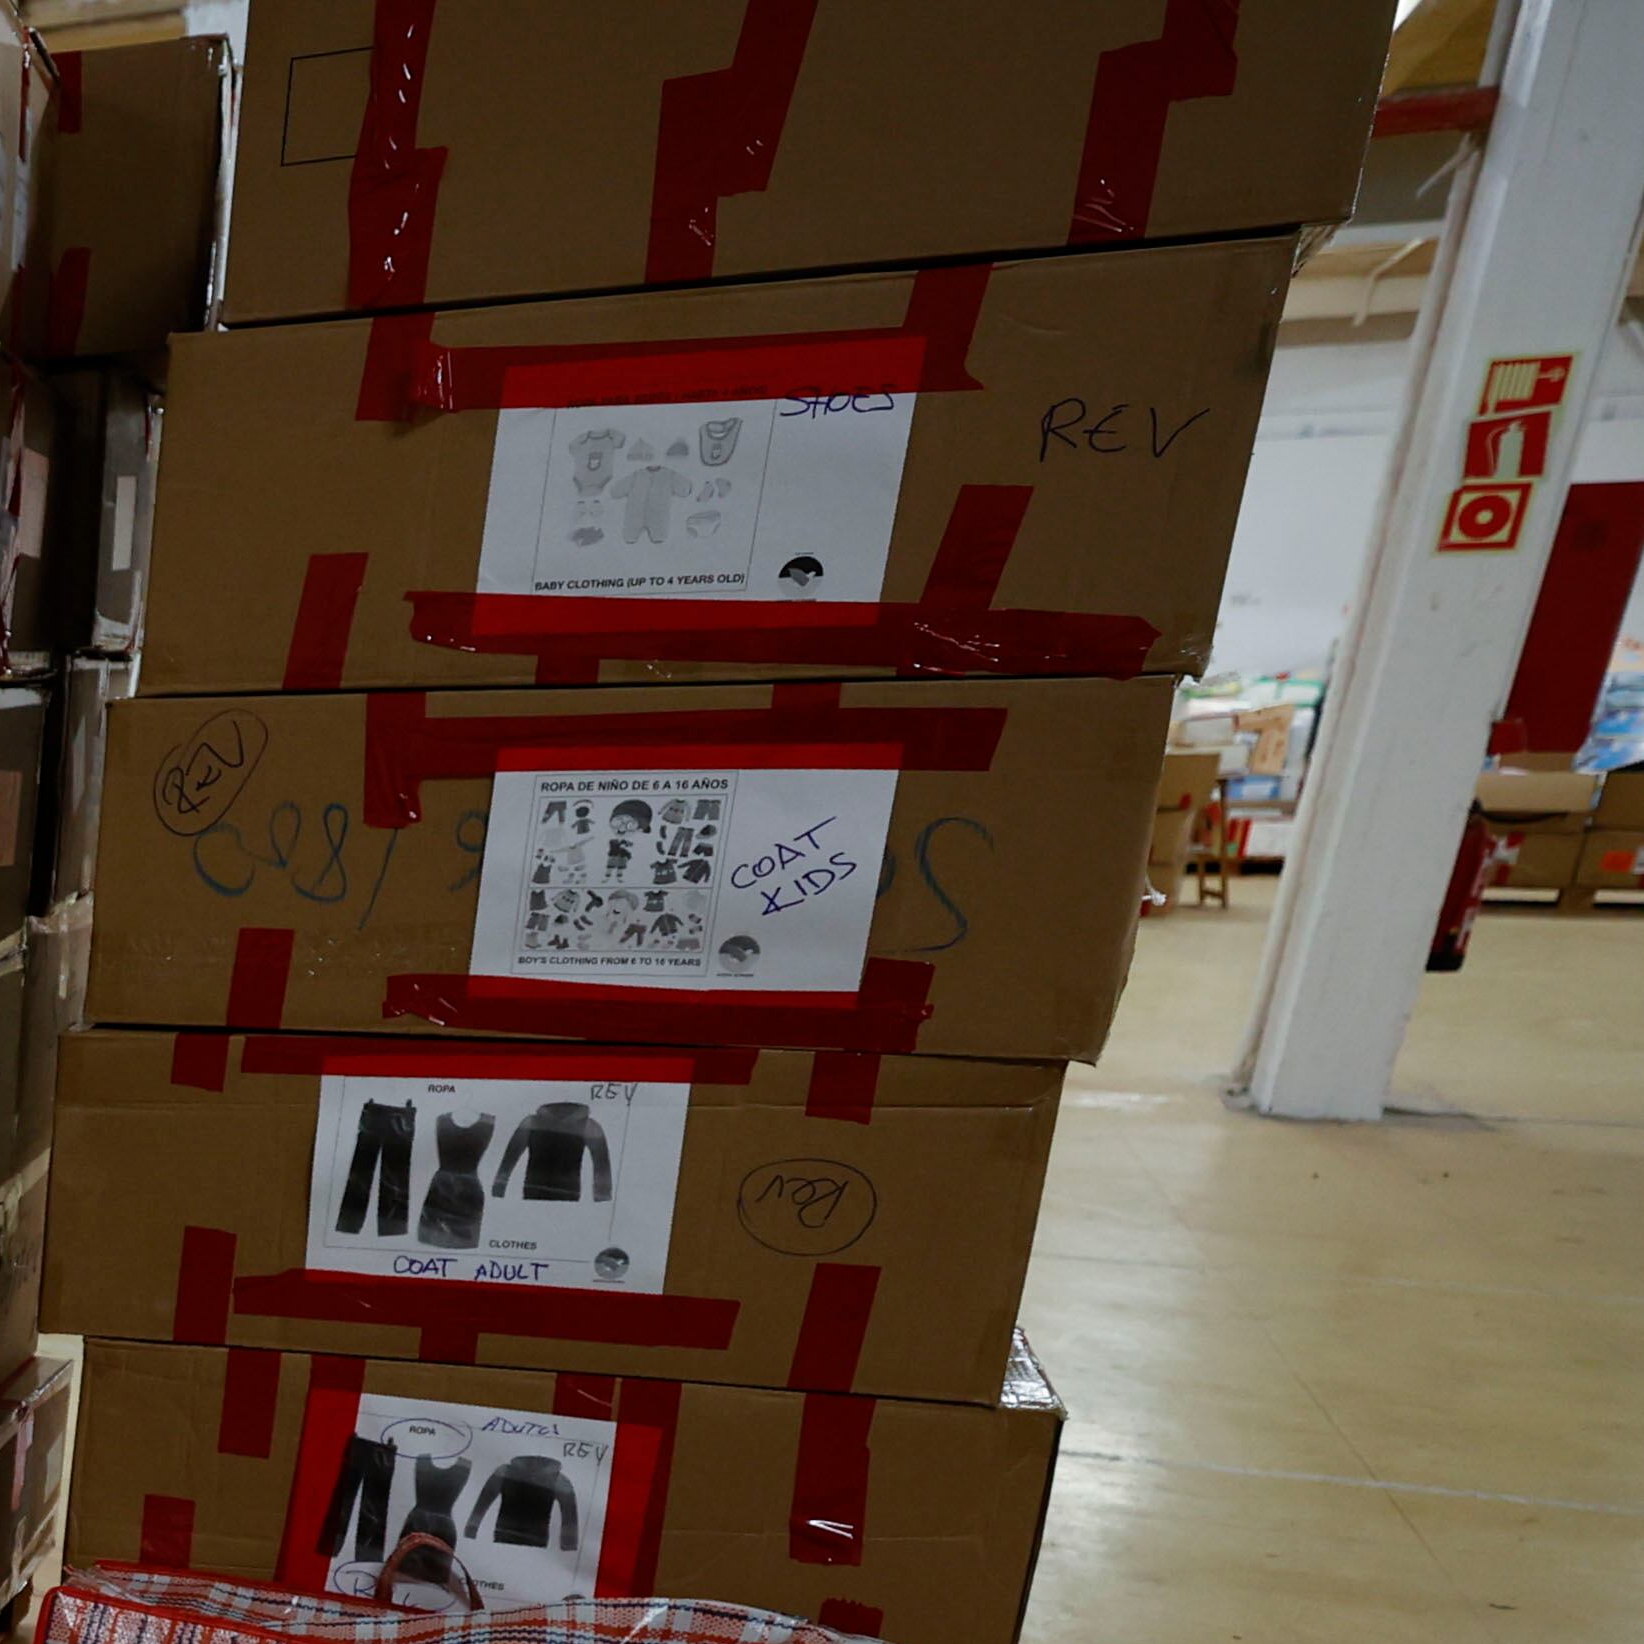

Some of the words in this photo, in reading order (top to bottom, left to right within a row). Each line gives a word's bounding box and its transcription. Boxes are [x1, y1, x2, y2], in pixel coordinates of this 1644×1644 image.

[1038, 397, 1211, 462] REV
[534, 581, 565, 592] BABY
[566, 578, 624, 590] CLOTHING
[626, 577, 648, 589] (UP
[649, 577, 666, 588] TO
[667, 577, 674, 587] 4
[677, 575, 714, 587] YEARS
[716, 574, 746, 586] OLD)
[540, 781, 575, 792] ROPA
[577, 781, 594, 791] DE
[598, 778, 629, 791] NIÑO
[631, 780, 650, 791] DE
[652, 780, 660, 790] 6
[662, 780, 672, 790] A
[675, 780, 687, 790] 16
[690, 777, 729, 790] AÑOS
[730, 816, 837, 890] COAT
[760, 852, 857, 916] KIDS
[548, 956, 598, 966] CLOTHING
[600, 956, 631, 966] FROM
[639, 956, 653, 967] TO
[667, 957, 702, 968] YEARS
[427, 1083, 457, 1095] ROPA
[488, 1238, 538, 1251] CLOTHES
[393, 1255, 458, 1278] COAT
[474, 1261, 550, 1283] ADULT
